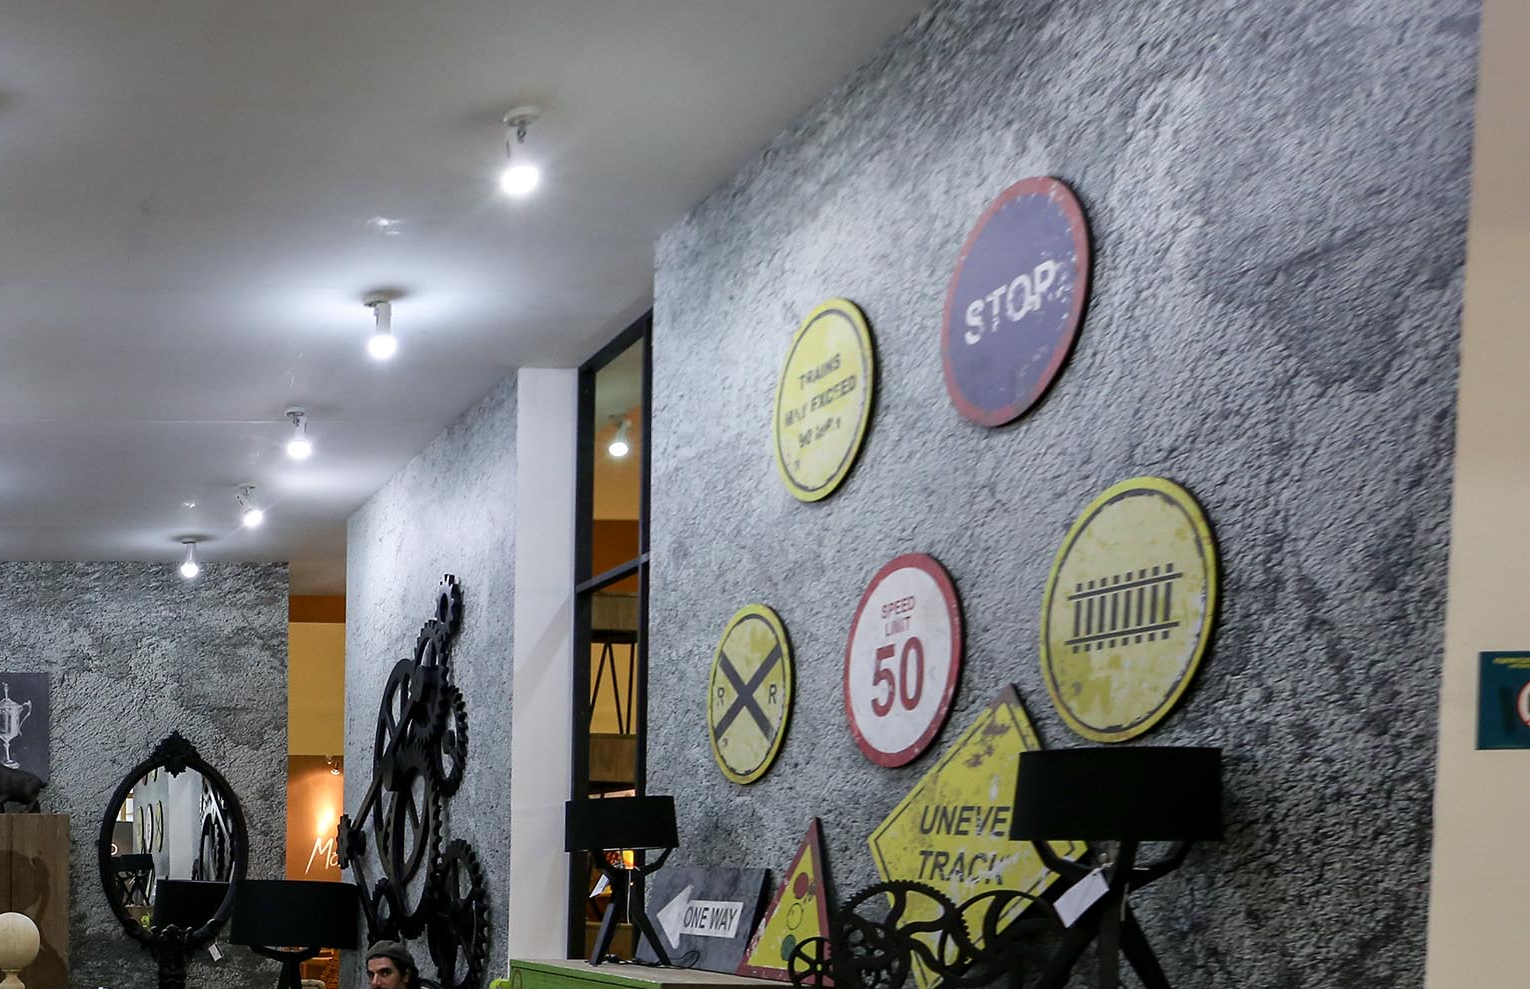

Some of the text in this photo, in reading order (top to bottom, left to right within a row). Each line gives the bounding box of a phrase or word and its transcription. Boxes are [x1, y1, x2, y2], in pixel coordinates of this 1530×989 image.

[964, 258, 1058, 345] STOP
[811, 374, 857, 411] EXCEED
[881, 595, 917, 619] SPEED
[871, 636, 925, 718] 50
[716, 687, 726, 707] R
[768, 684, 779, 706] R
[919, 805, 1012, 837] UNEVE
[918, 850, 1012, 886] TRACK
[683, 906, 738, 931] ONE WAY
